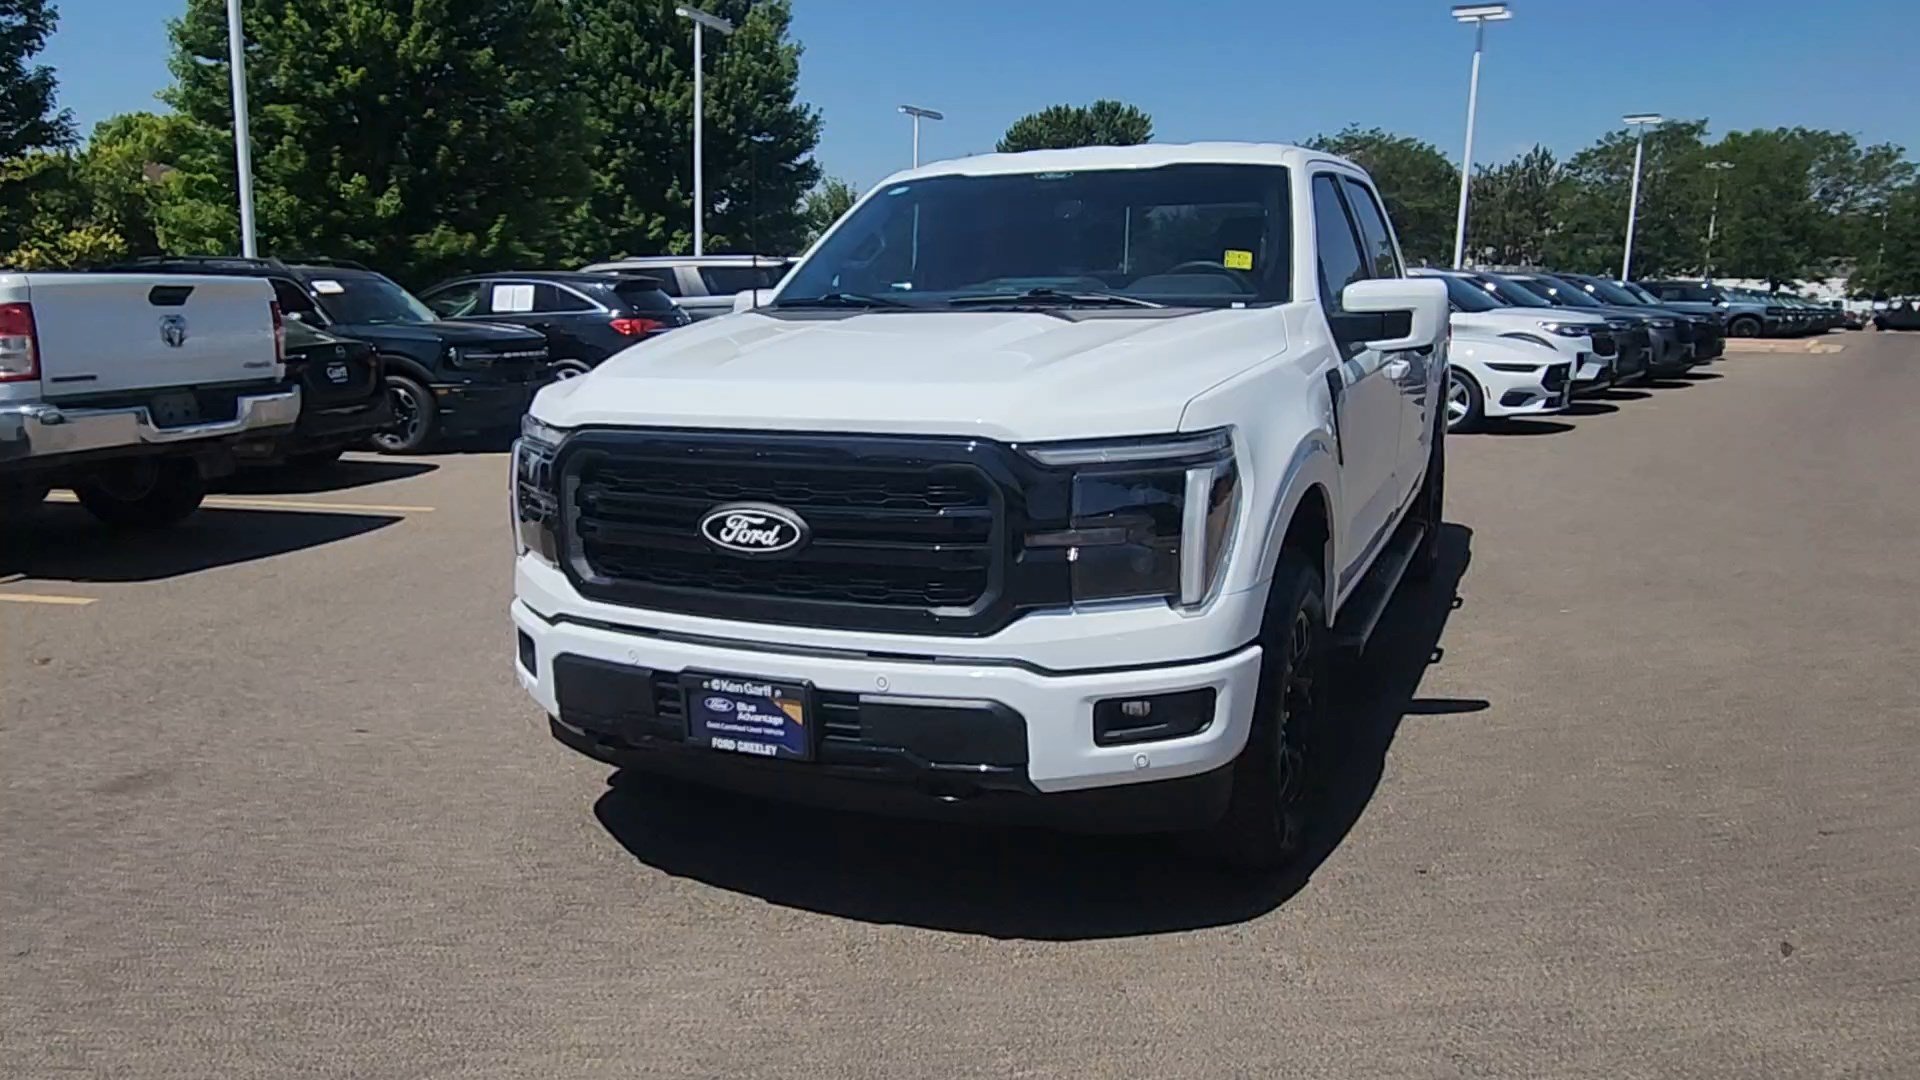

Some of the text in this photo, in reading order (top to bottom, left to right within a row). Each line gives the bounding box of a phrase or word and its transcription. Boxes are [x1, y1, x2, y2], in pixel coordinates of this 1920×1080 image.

[720, 515, 781, 546] Ford
[721, 680, 743, 693] Ken
[737, 711, 784, 726] Advantage
[711, 737, 777, 756] FORD GREELEY
